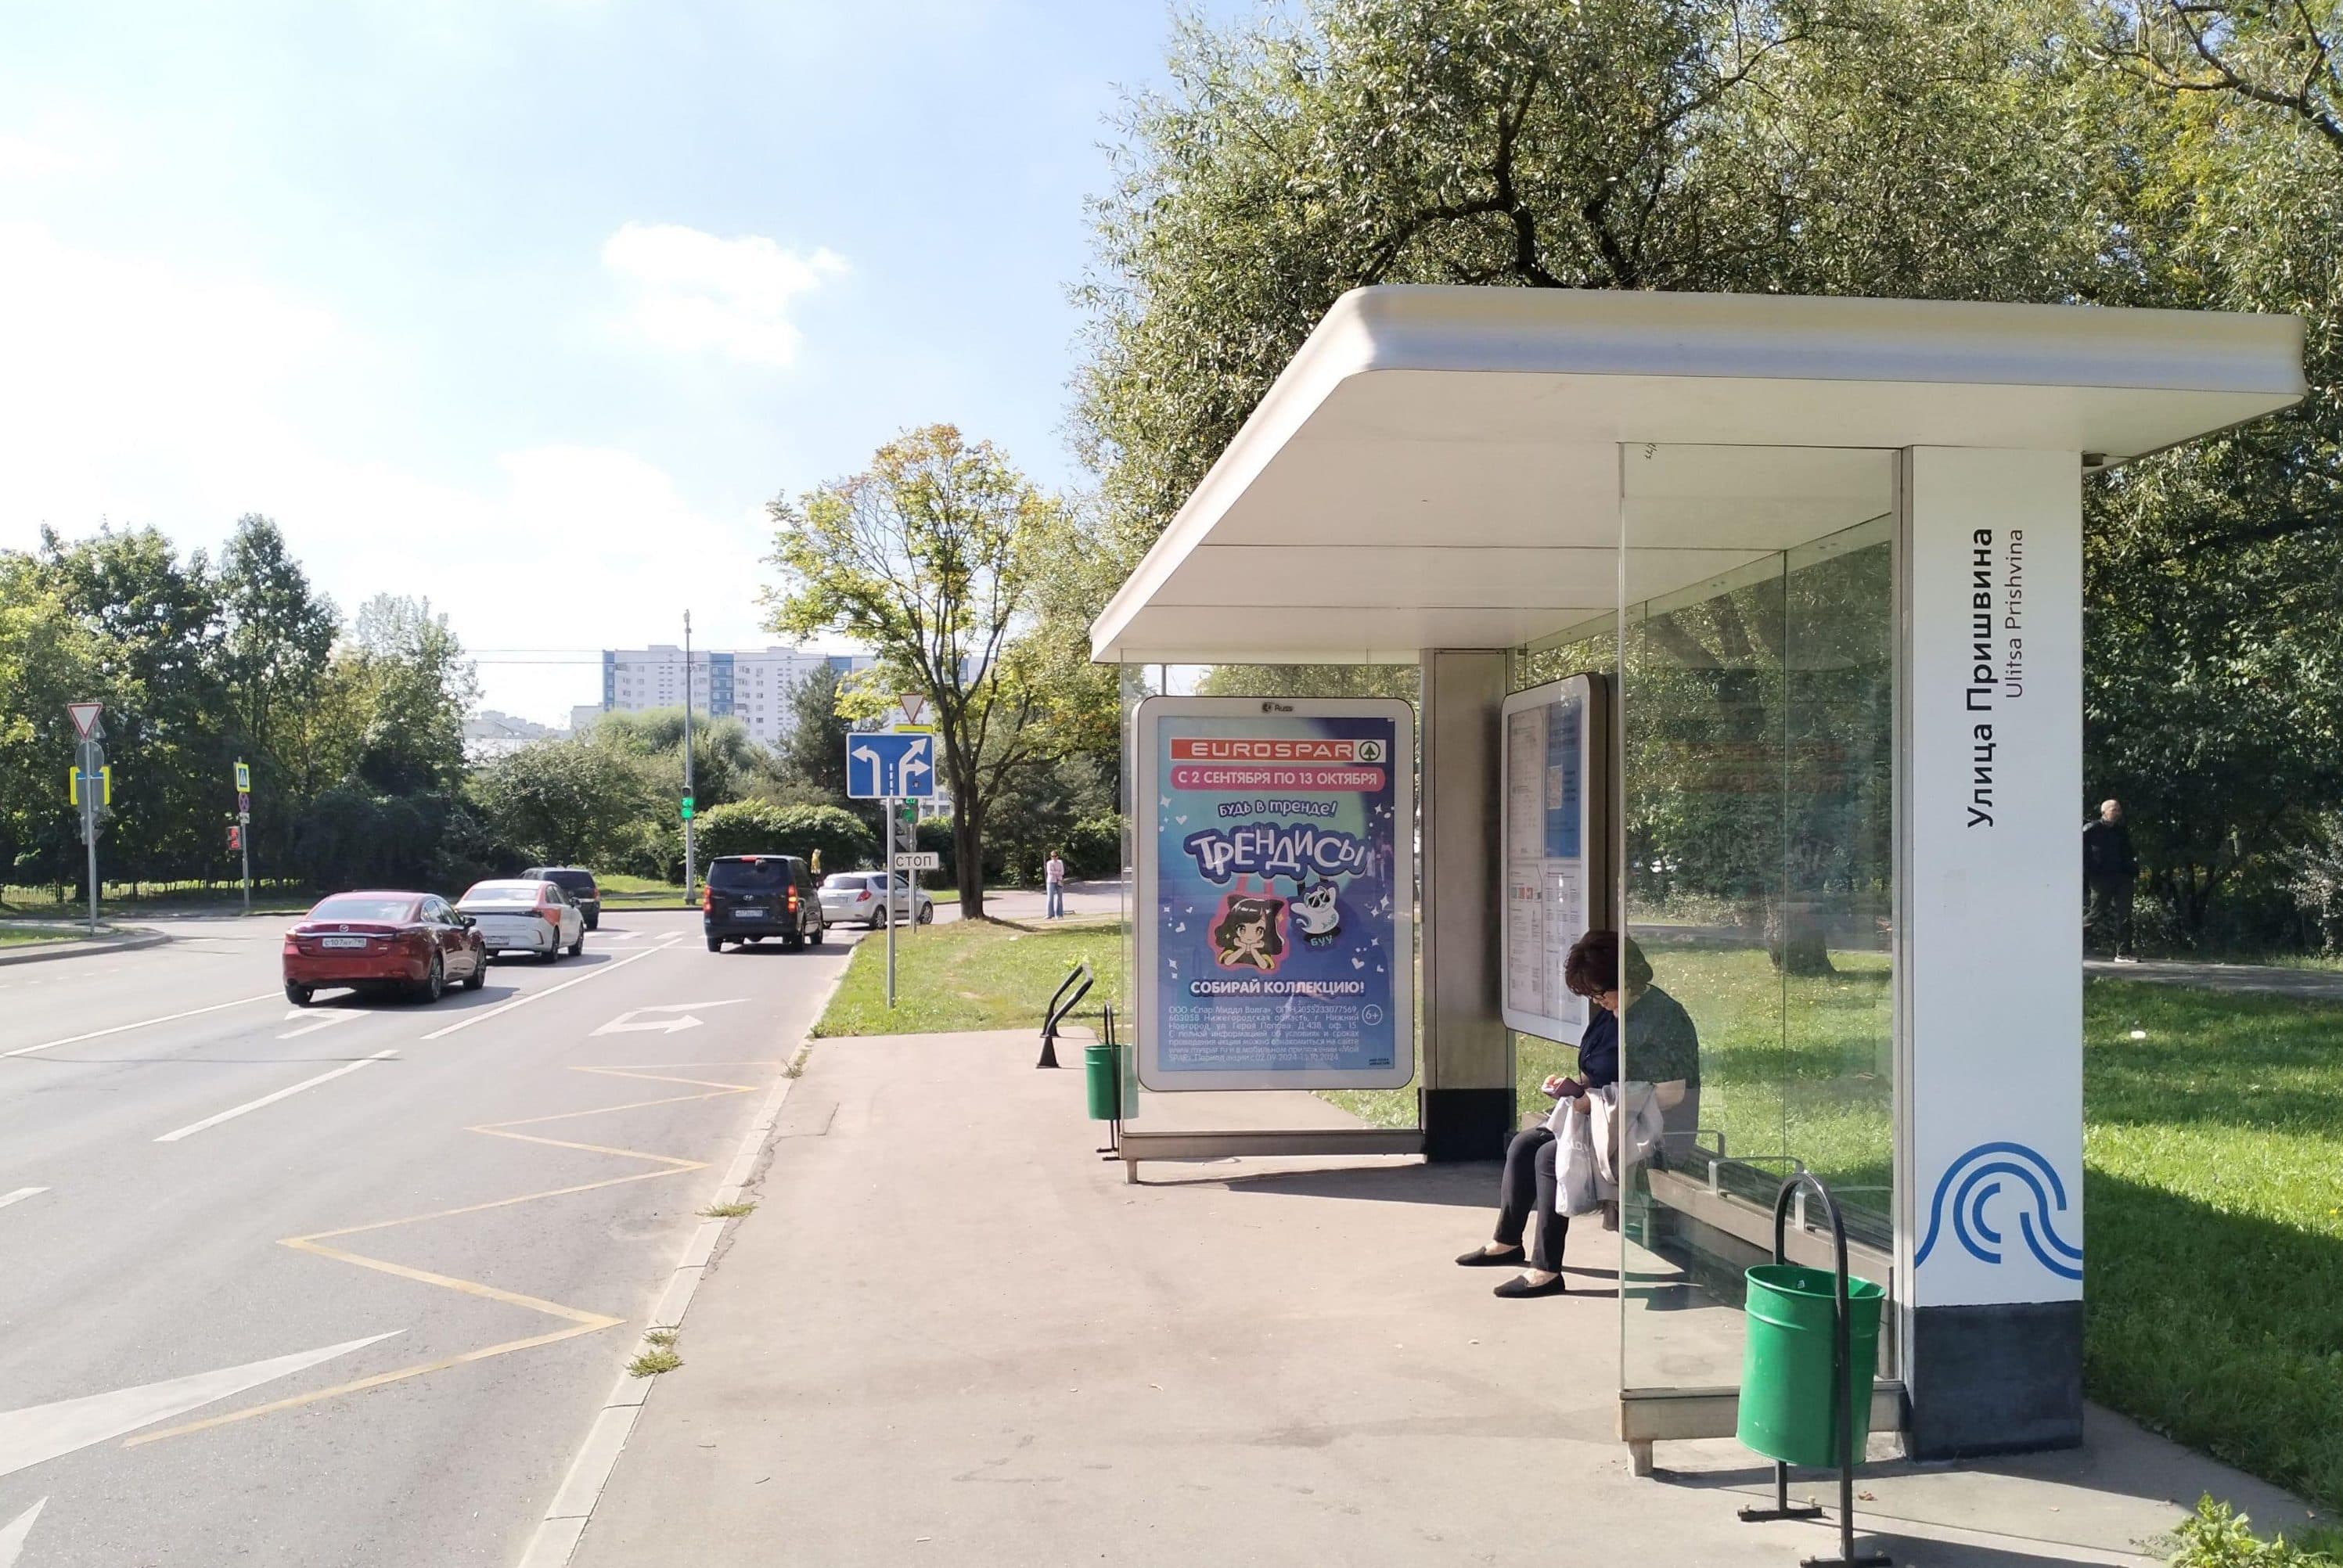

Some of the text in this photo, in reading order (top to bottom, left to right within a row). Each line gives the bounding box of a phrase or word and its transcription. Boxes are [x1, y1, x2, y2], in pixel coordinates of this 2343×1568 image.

[2004, 529, 2023, 698] Ulitsa Prishvina
[1966, 528, 1999, 828] Улица Пришвина
[1190, 742, 1352, 758] EUROSPAR
[1178, 771, 1378, 786] С 2 СЕНТЯБРЯ ПО 13 ОКТЯБРЯ
[1189, 829, 1366, 876] ТРЕНДИСЫ
[895, 856, 931, 868] СТОП
[1190, 979, 1365, 995] СОБИРАЙ КОЛЛЕКЦИЮ!
[1365, 1009, 1379, 1020] 6+
